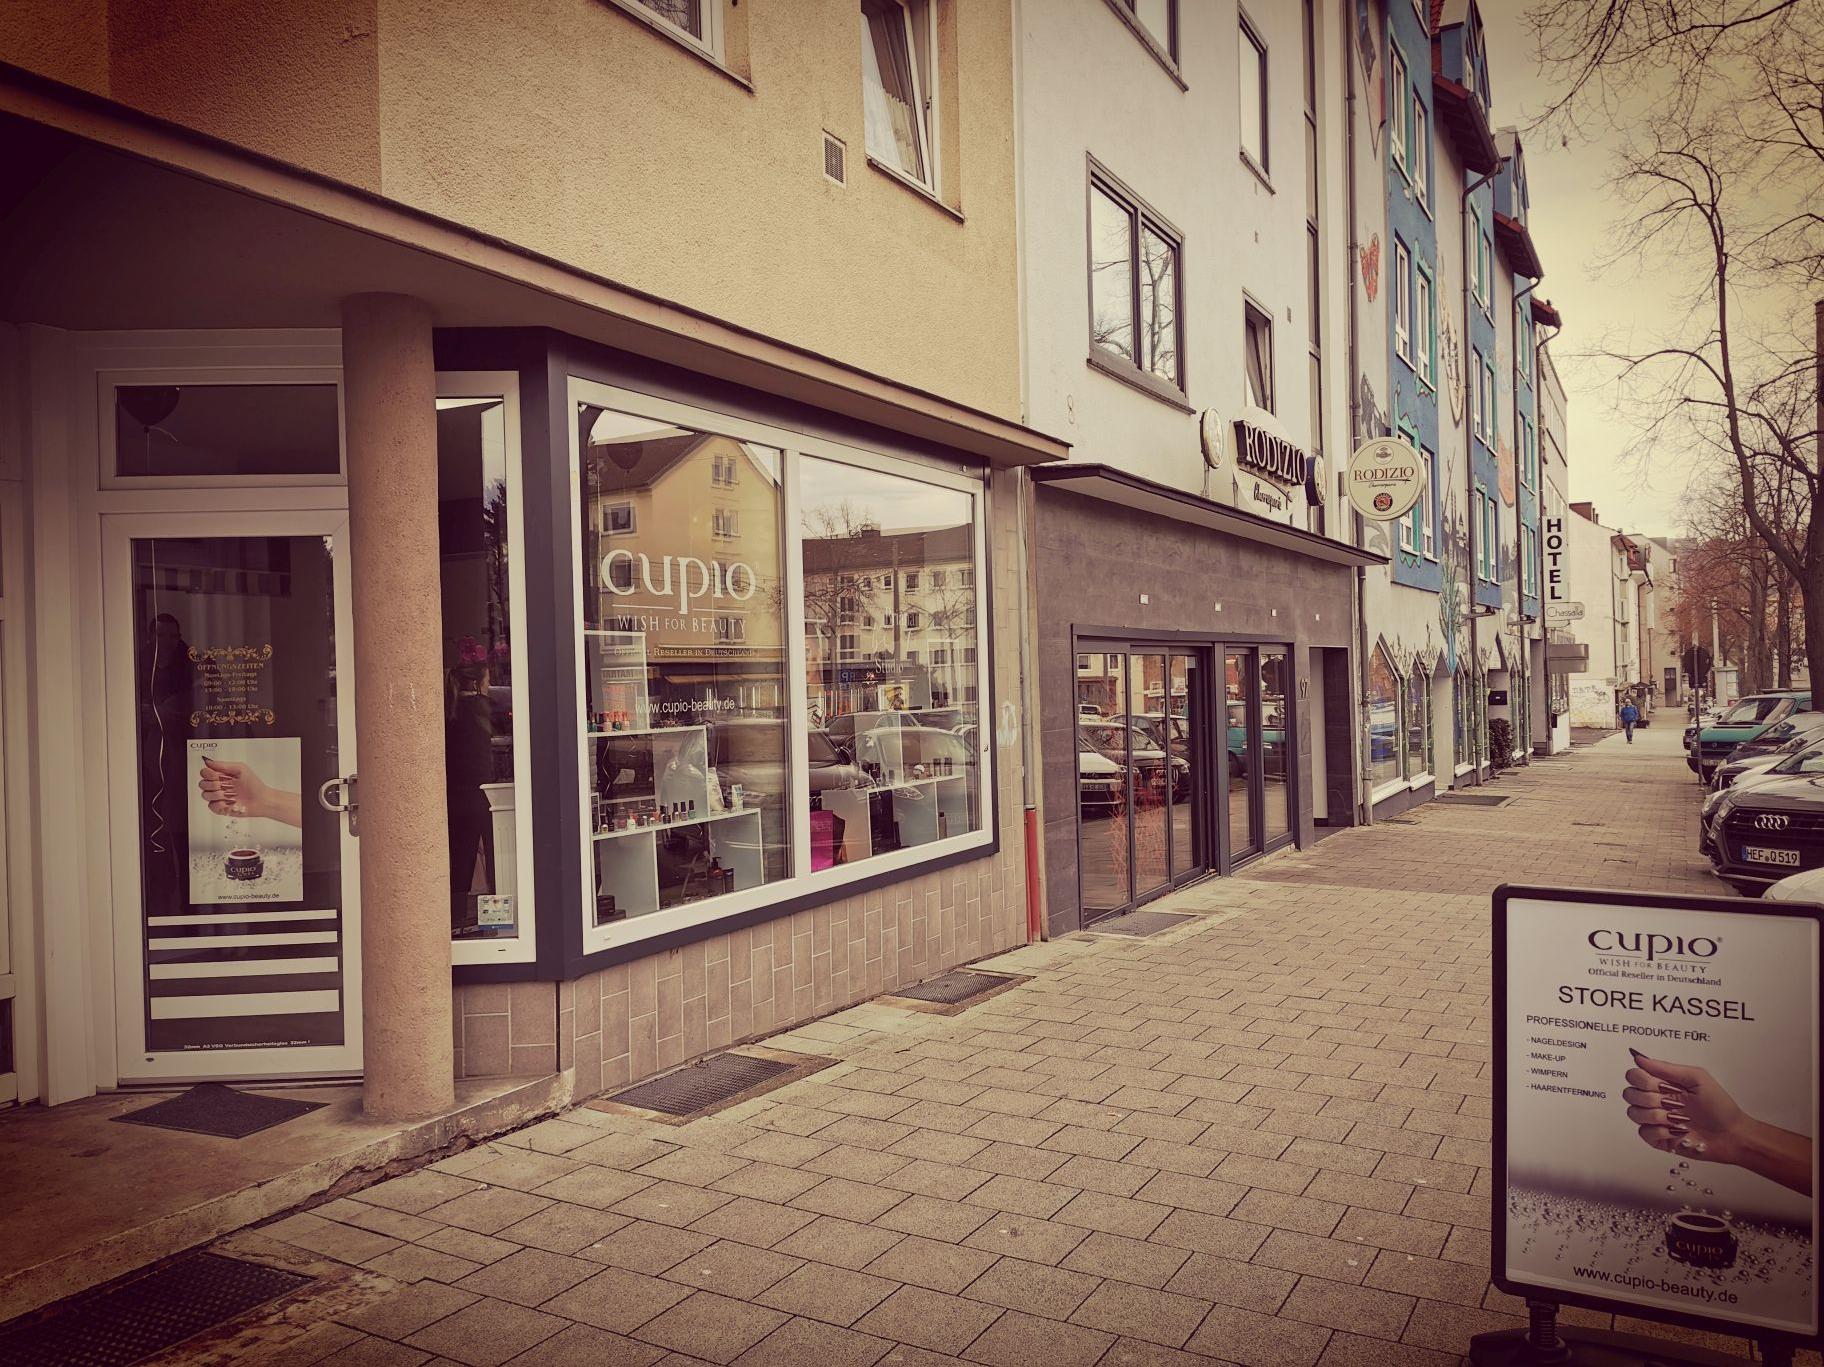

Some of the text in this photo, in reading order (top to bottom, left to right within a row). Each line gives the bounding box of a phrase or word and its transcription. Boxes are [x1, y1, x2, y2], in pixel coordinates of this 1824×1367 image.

[1243, 420, 1308, 486] RODIZIO
[1353, 466, 1414, 481] RODIZIO
[1546, 518, 1563, 600] HOTEL
[618, 614, 747, 633] WISH FOR BEAUTY
[875, 658, 904, 674] Studio
[635, 697, 735, 716] www.cupio-beauty.de
[1746, 848, 1764, 861] HEF
[217, 893, 280, 901] www.cupio-beauty.de
[1599, 957, 1708, 974] WISH FOR BEAUTY
[1588, 967, 1722, 986] Official Reseller in Deutschland
[1558, 985, 1755, 1022] STORE KASSEL
[1526, 1015, 1711, 1043] PROFESSIONELLE PRODUKTE FÜR:
[1530, 1036, 1588, 1050] NAGELDESIGN
[1530, 1052, 1567, 1063] MAKE-UP
[1530, 1067, 1569, 1079] WIMPERN
[1530, 1083, 1607, 1100] HAARENTFERNUNG
[1573, 1266, 1739, 1304] www.cupio-beauty.de
